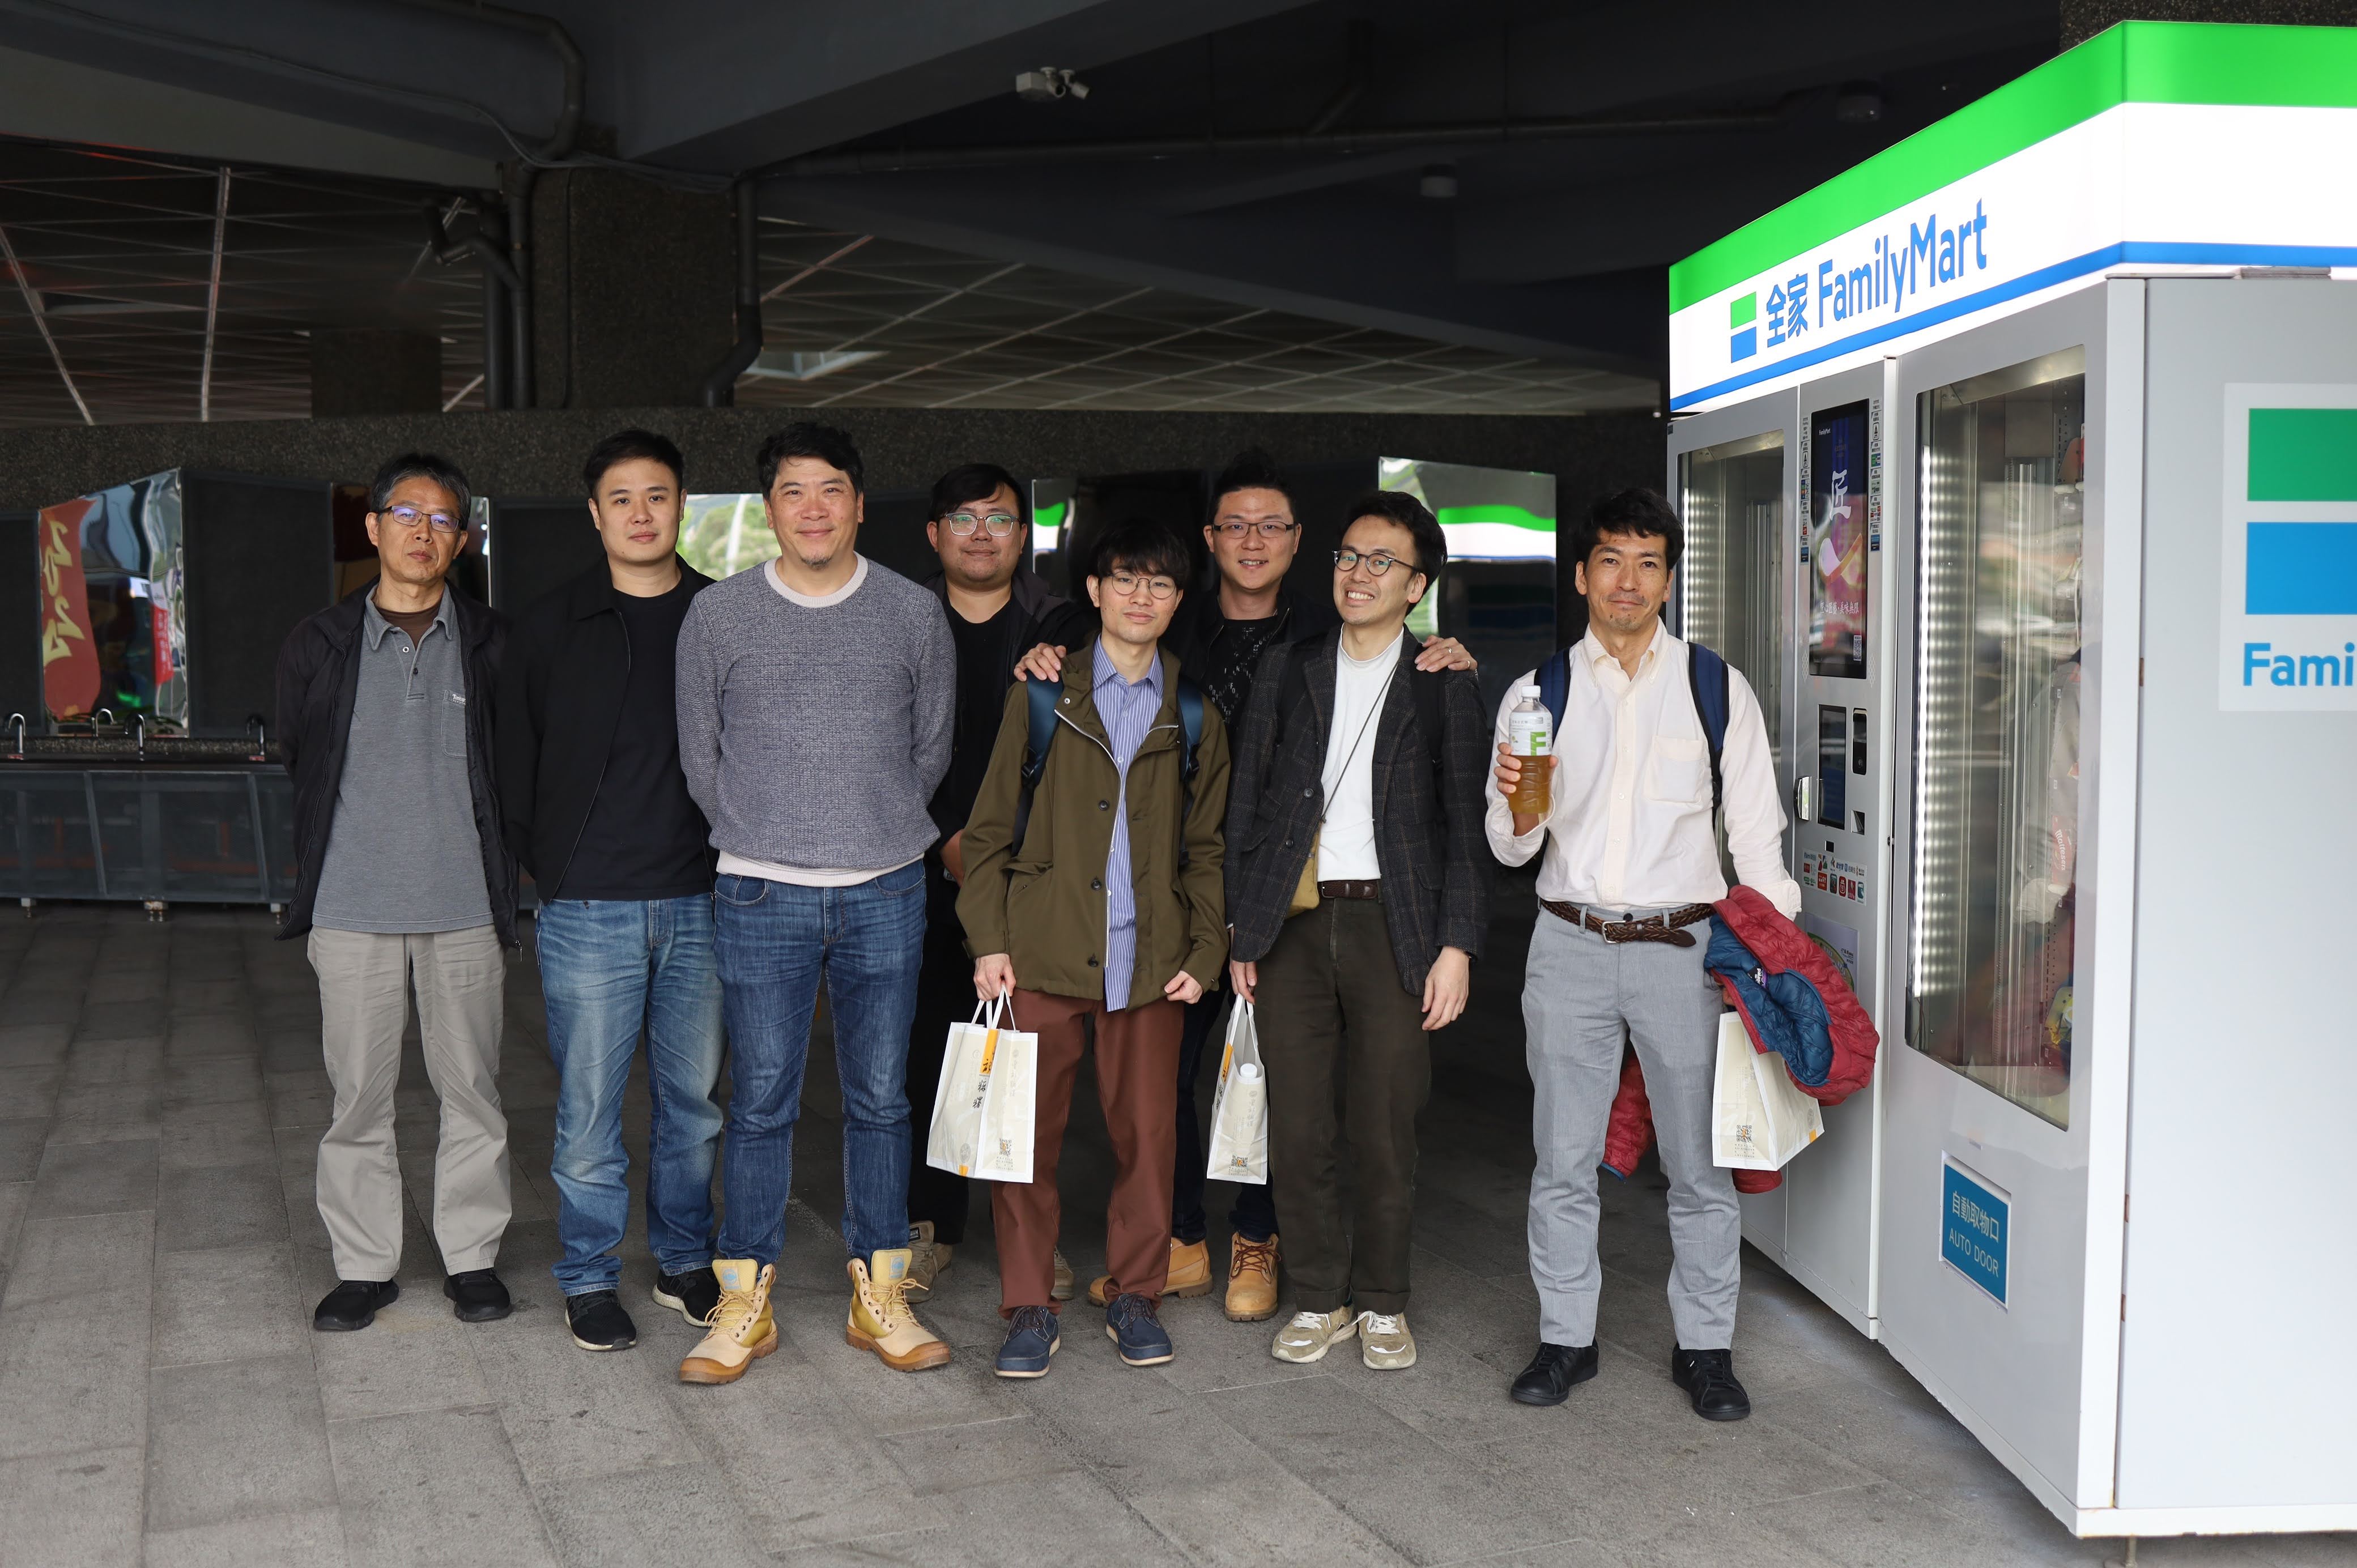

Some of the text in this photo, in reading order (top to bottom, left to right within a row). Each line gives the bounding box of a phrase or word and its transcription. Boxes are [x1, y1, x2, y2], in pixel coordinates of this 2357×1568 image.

[1765, 198, 1988, 348] 全家 FamilyMart
[1829, 469, 1852, 521] 匠
[2243, 642, 2356, 687] Fami
[1952, 1191, 1999, 1243] 自動取物口
[1950, 1228, 1999, 1278] AUTO DOOR
